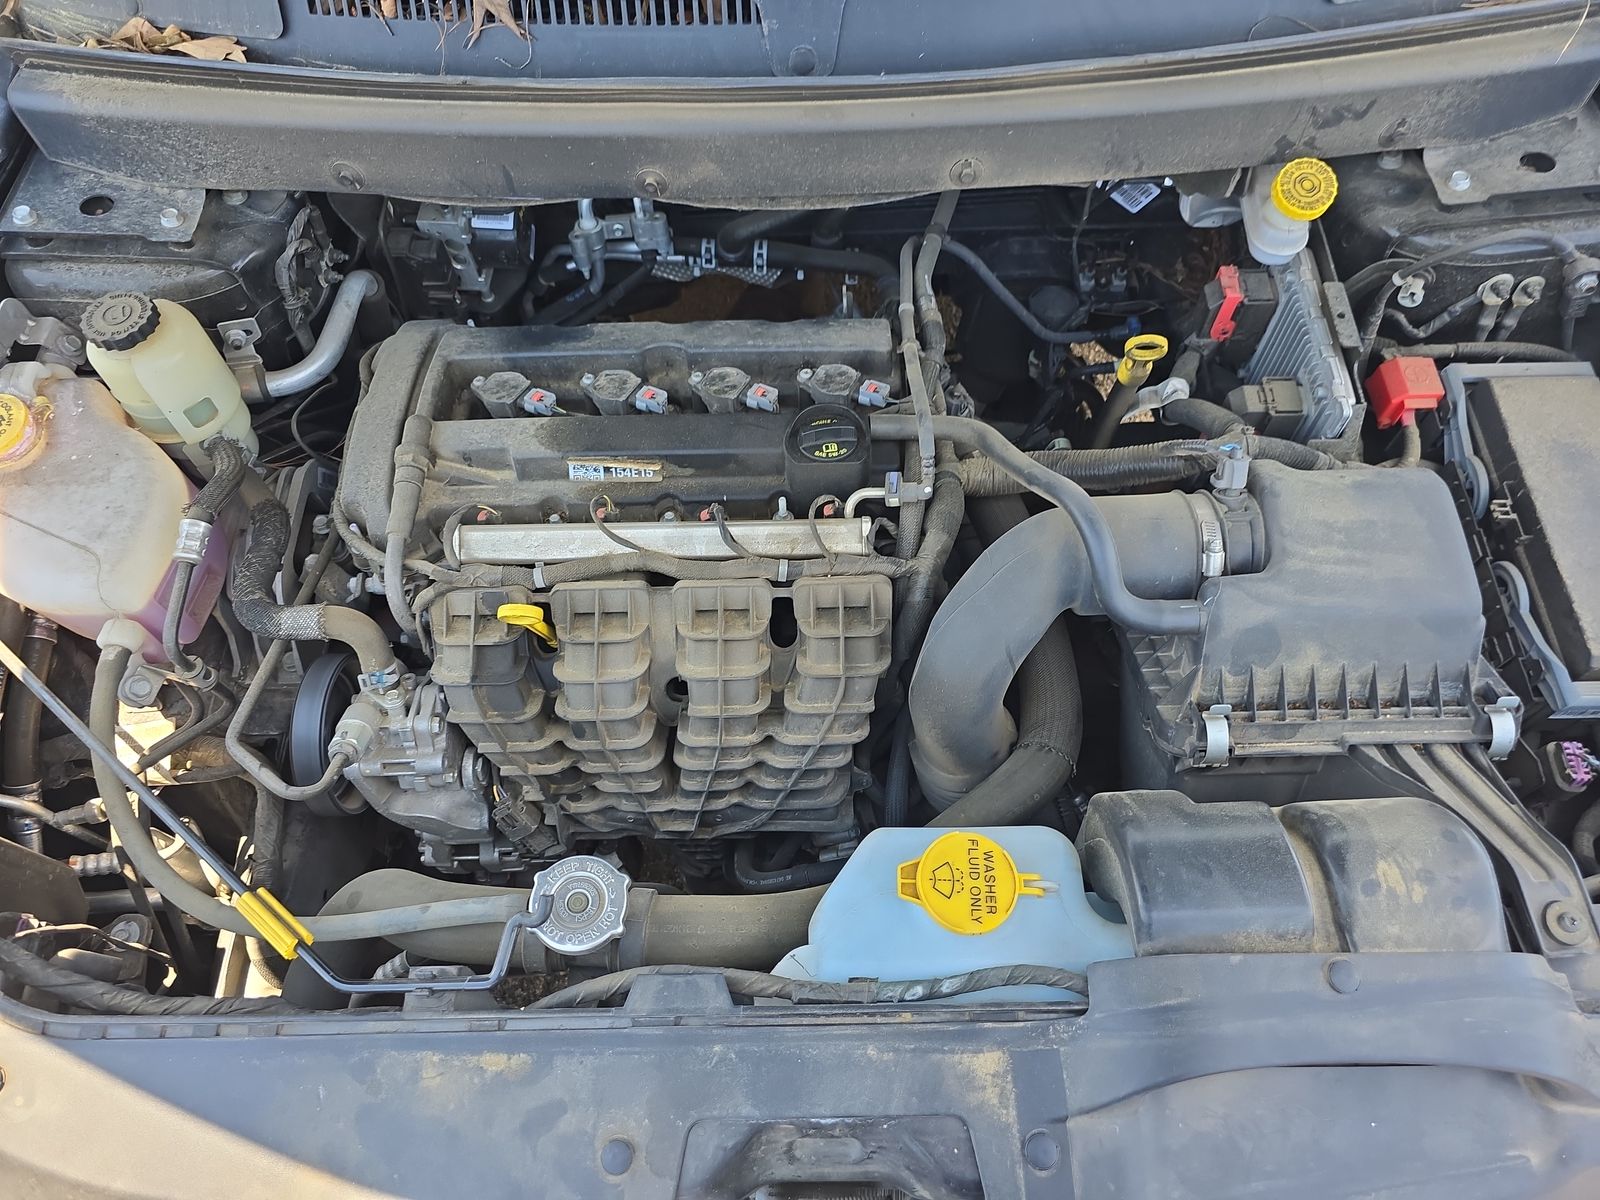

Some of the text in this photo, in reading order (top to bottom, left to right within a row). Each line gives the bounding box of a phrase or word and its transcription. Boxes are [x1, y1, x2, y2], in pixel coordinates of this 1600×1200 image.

[547, 861, 615, 884] KEEP TIGHT
[967, 838, 983, 925] FLUID ONLY
[983, 850, 998, 915] WASHER
[541, 904, 618, 944] NOT OPEN HOT
